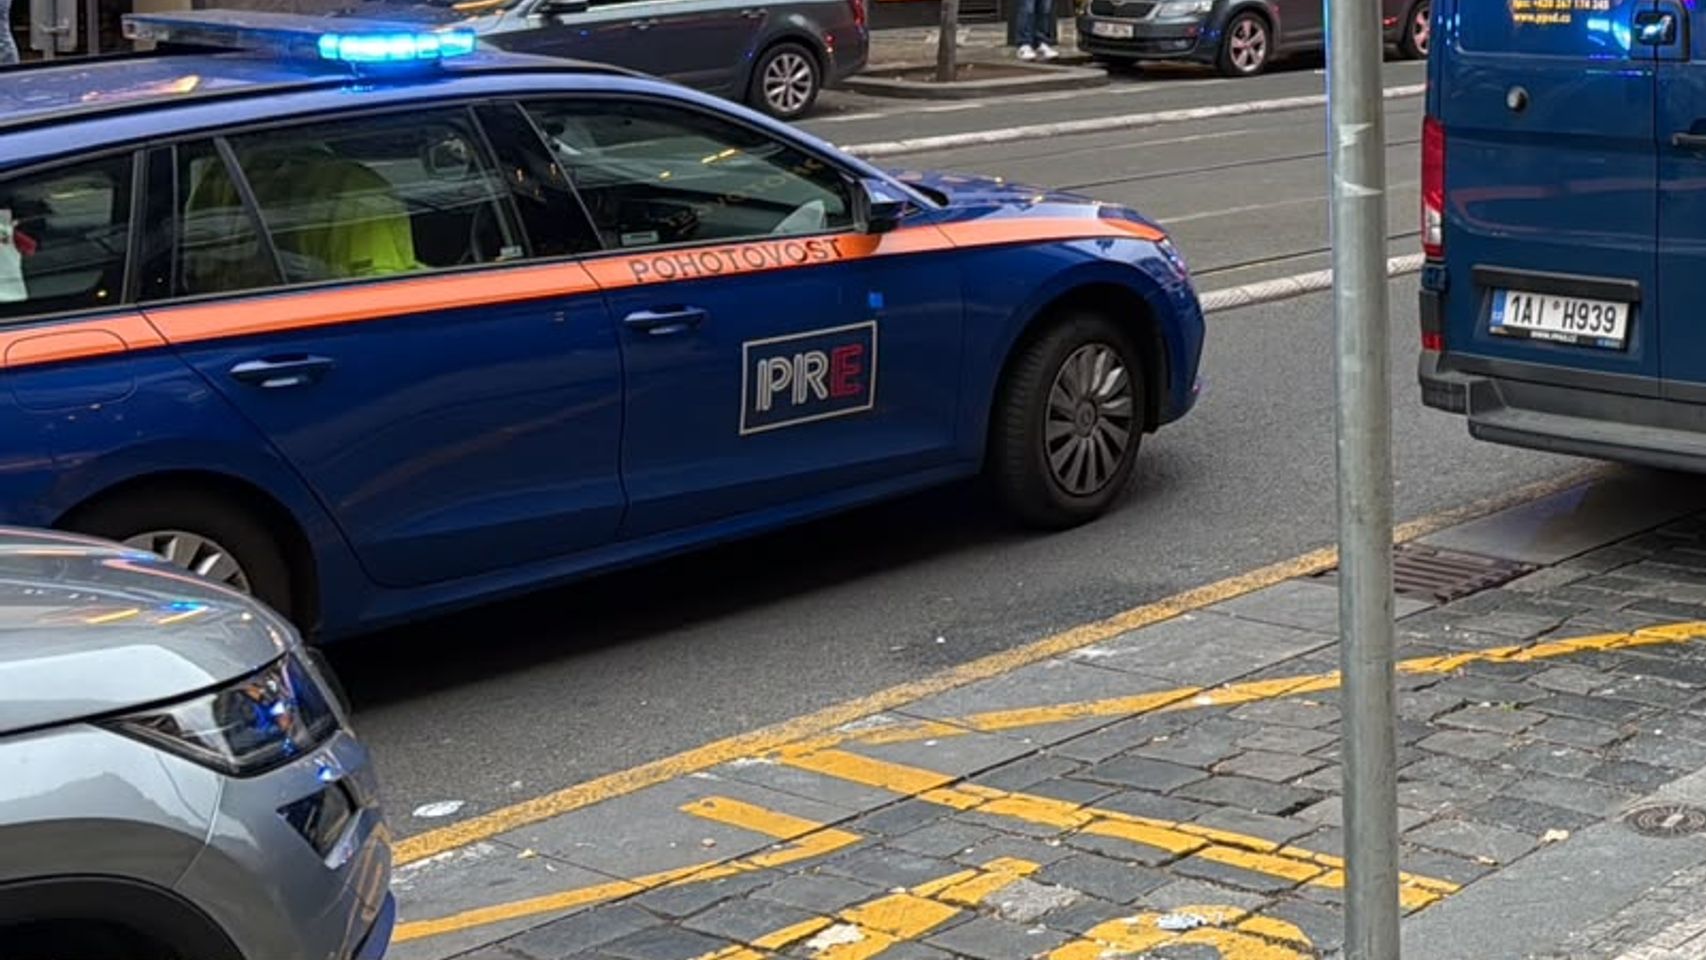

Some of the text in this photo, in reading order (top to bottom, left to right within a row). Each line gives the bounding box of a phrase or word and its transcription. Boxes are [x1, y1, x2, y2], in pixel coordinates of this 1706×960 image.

[628, 238, 844, 283] POHOTOVOST
[1511, 294, 1616, 334] 1AI H939
[756, 343, 864, 411] PRE
